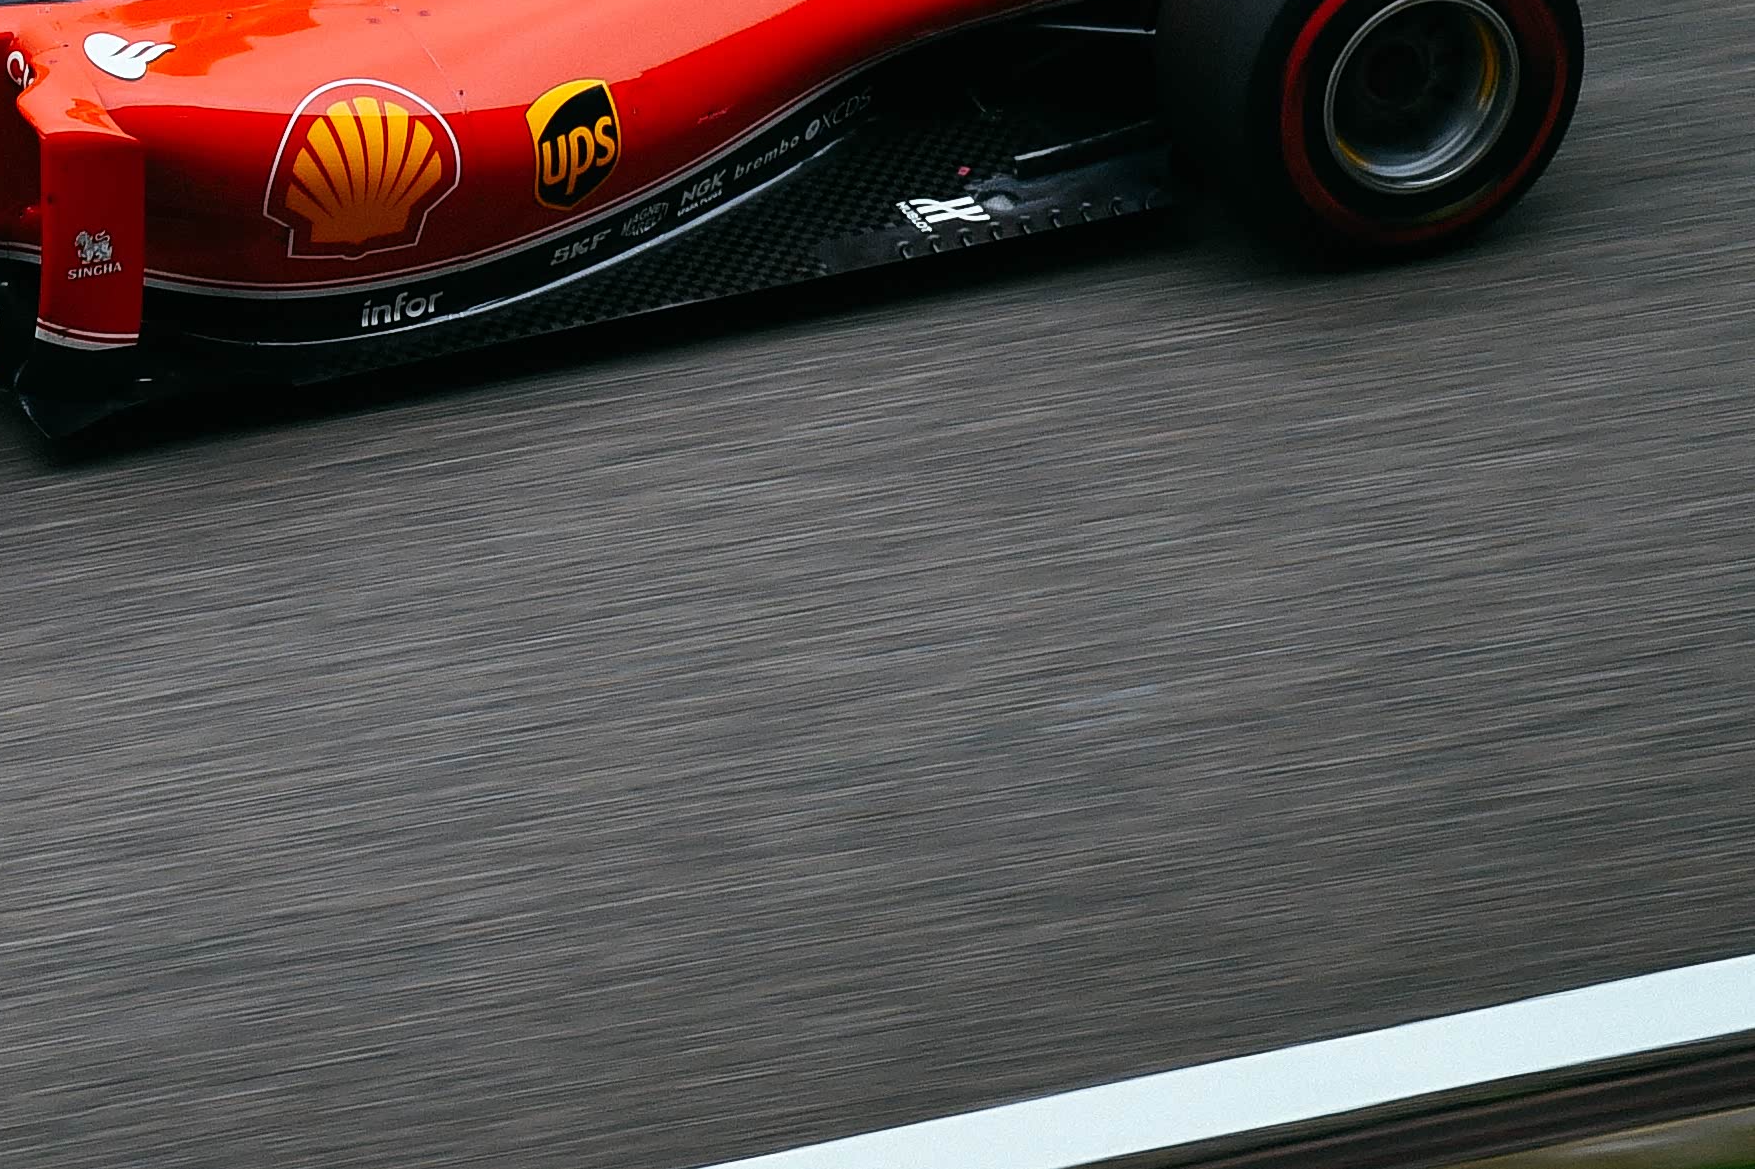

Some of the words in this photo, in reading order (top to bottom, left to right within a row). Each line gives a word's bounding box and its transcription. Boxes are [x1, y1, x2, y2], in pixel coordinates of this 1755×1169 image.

[542, 115, 616, 196] ups
[733, 136, 799, 181] brembo
[680, 169, 726, 206] NGK
[550, 228, 613, 266] SKF
[67, 261, 122, 280] SINGHA
[361, 291, 444, 327] infor
